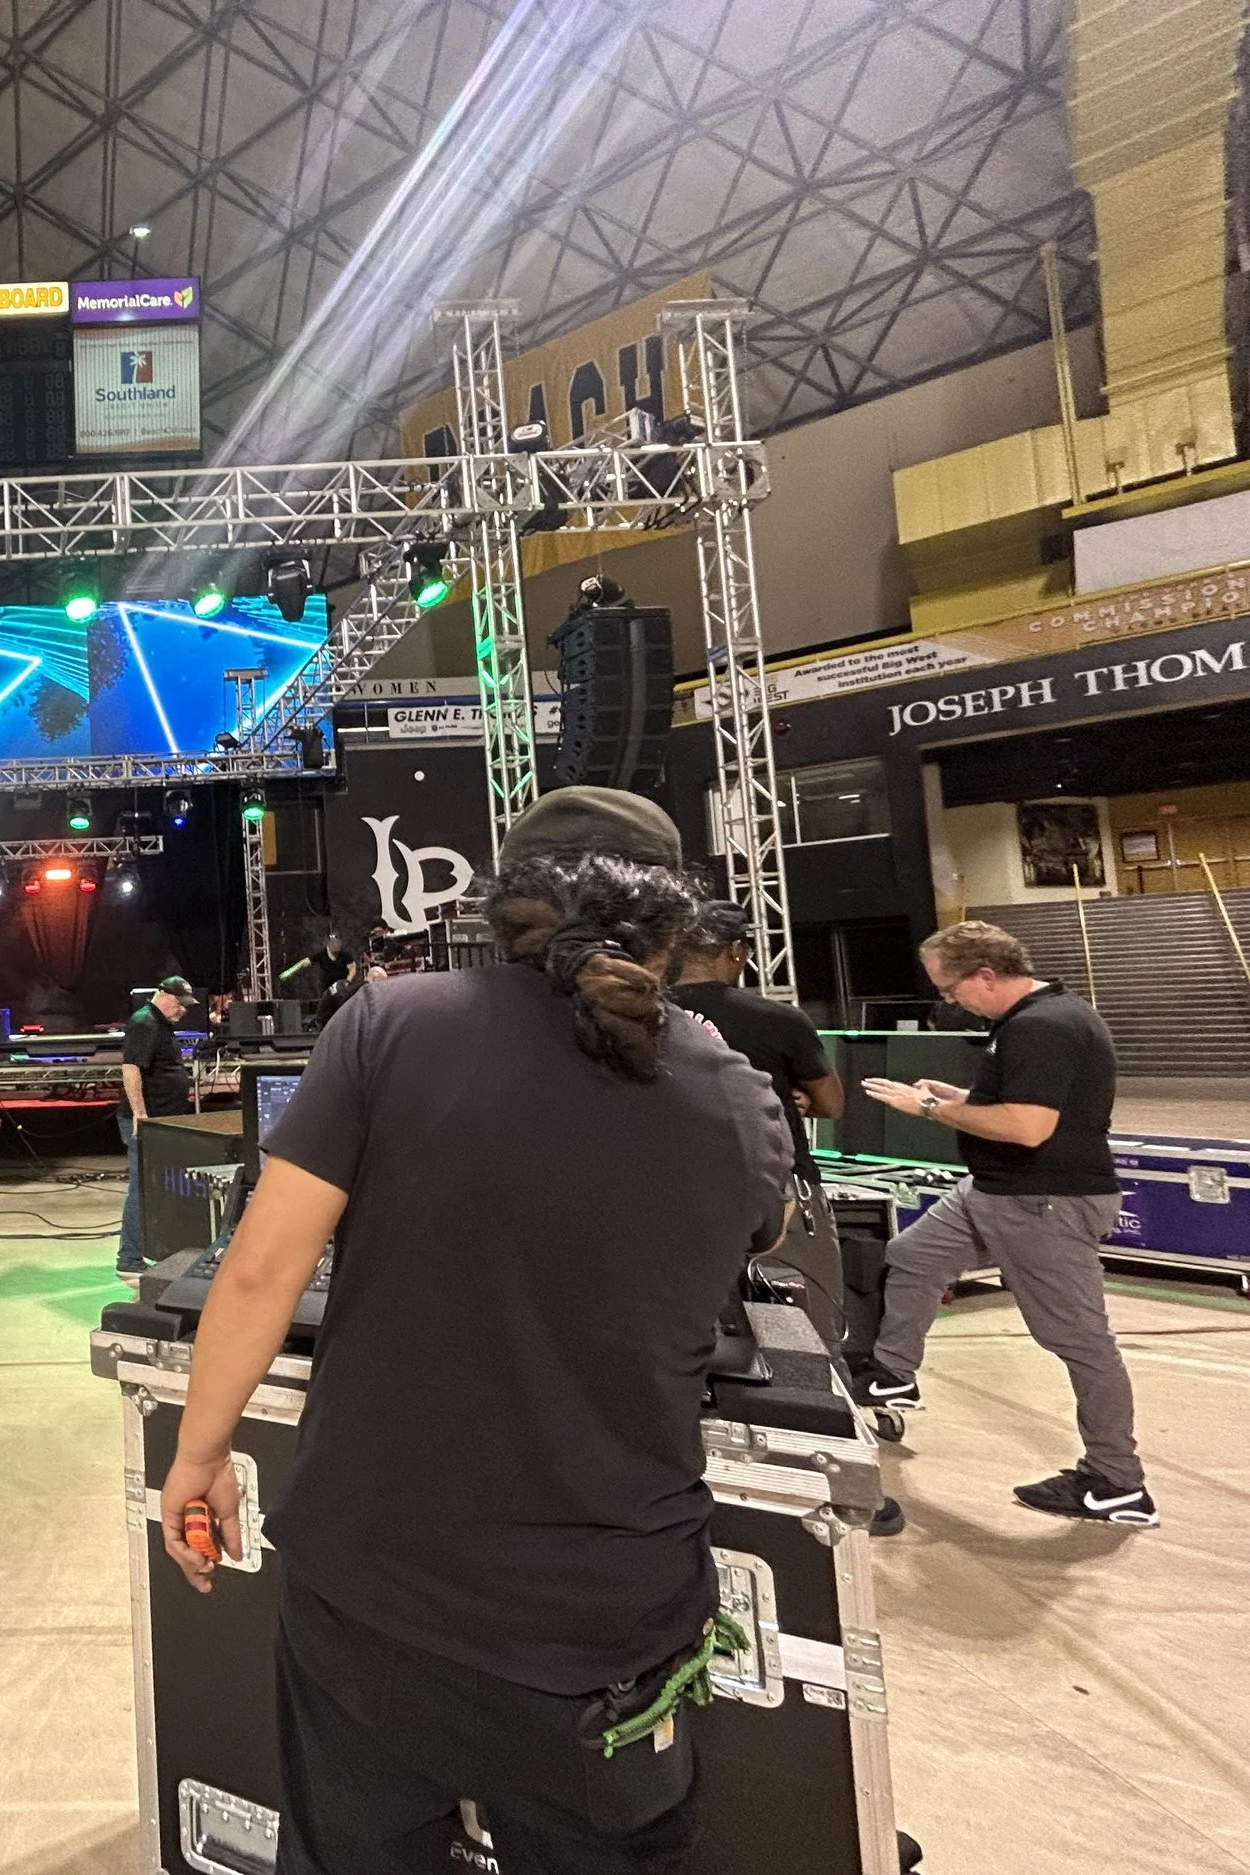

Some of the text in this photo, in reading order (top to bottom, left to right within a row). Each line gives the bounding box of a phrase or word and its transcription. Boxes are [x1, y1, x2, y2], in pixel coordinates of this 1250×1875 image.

[77, 294, 172, 311] MemorialCare
[95, 384, 176, 402] Southland
[794, 645, 919, 677] Awarded to the most
[817, 651, 938, 682] successful Big West
[838, 657, 968, 688] institution each year
[887, 641, 1250, 737] JOSEPH THOM
[394, 709, 448, 722] GLENN
[453, 709, 465, 720] E.
